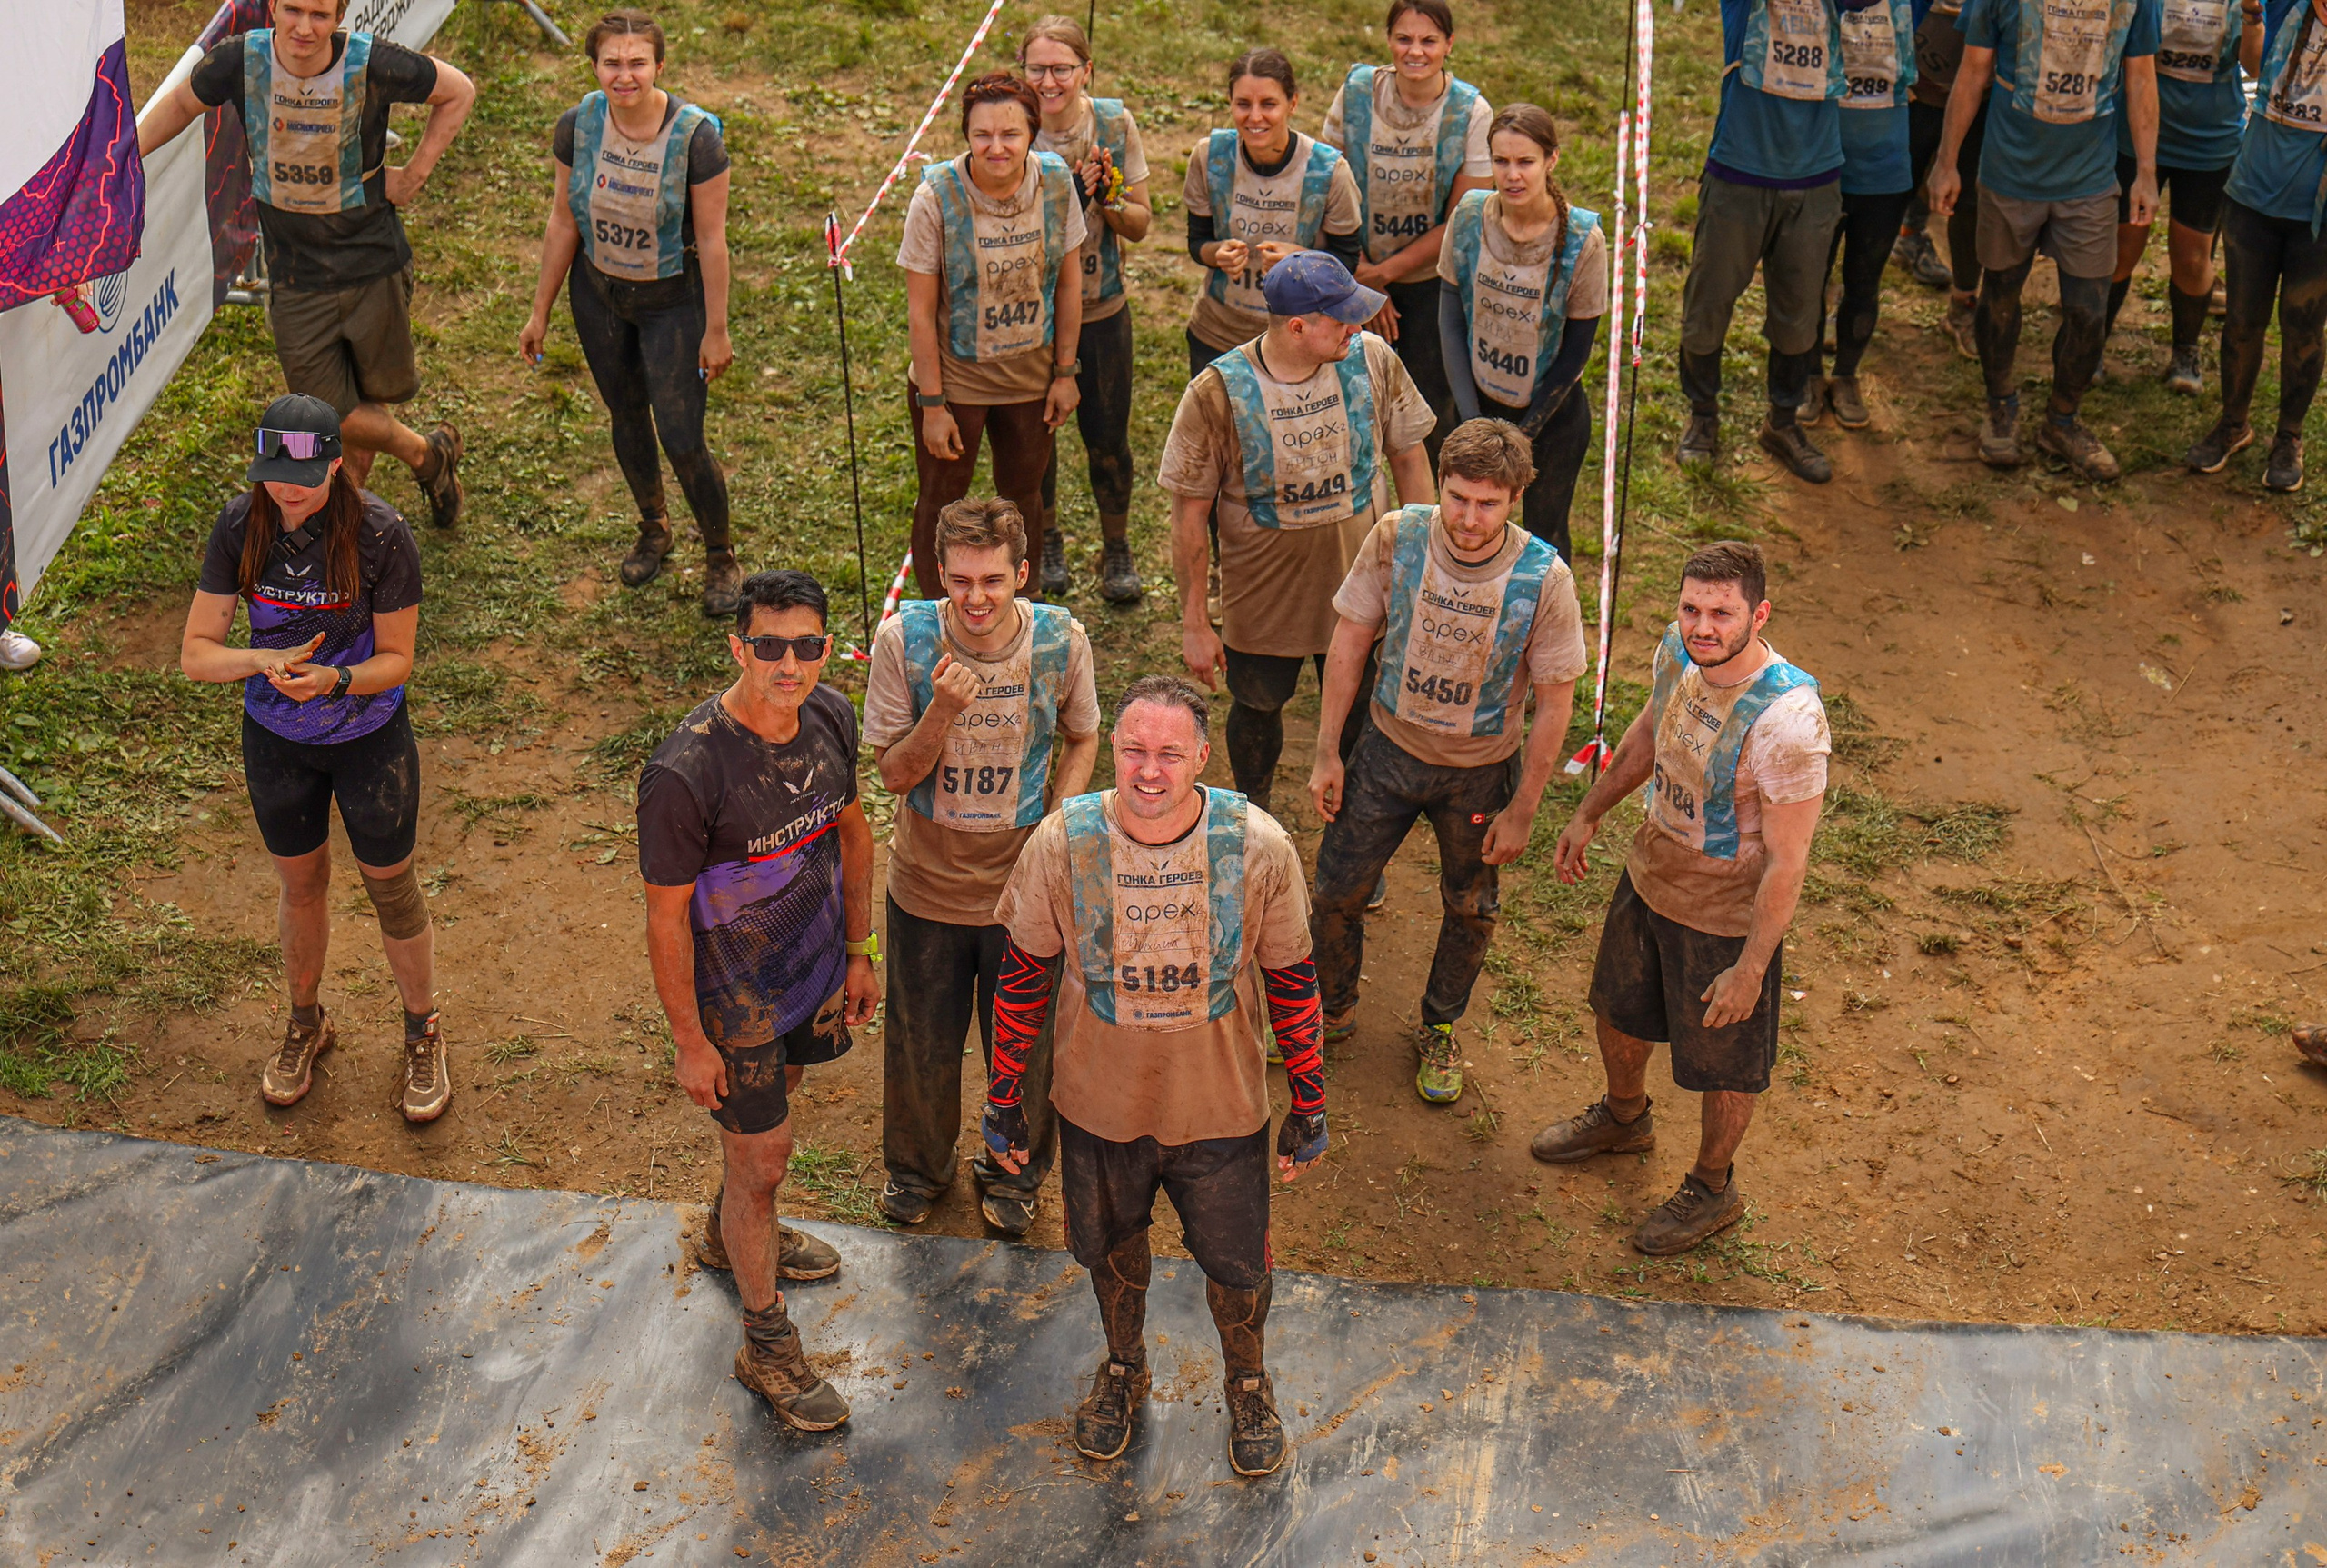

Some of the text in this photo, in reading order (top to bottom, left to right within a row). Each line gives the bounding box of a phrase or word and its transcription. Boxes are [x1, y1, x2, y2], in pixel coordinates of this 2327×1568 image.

[1773, 41, 1823, 68] 5288
[1850, 77, 1889, 95] 289
[2045, 71, 2095, 95] 5281
[275, 94, 338, 106] ГОНКА ГЕРОЕВ
[602, 150, 659, 171] ГОНКА ГЕРОЕВ
[1371, 143, 1433, 155] ГОНКА ГЕРОЕВ
[275, 162, 334, 185] 5359
[1374, 166, 1427, 184] apex
[1235, 193, 1296, 209] ГОНКА ГЕРОЕВ
[595, 219, 651, 250] 5372
[1236, 217, 1288, 236] apex
[1373, 212, 1429, 237] 5446
[978, 229, 1042, 245] ГОНКА ГЕРОЕВ
[986, 255, 1039, 276] apex
[1478, 272, 1541, 296] ГОНКА ГЕРОЕВ
[984, 300, 1041, 331] 5447
[1481, 297, 1532, 323] apex
[1477, 337, 1529, 377] 5440
[48, 266, 180, 489] ГАЗПРОМБАНК
[1271, 394, 1340, 417] ГОНКА ГЕРОЕВ
[1283, 421, 1339, 449] apex
[1283, 473, 1346, 504] 5449
[1422, 590, 1496, 615] ГОНКА ГЕРОЕВ
[1422, 619, 1484, 644] apex
[985, 684, 1024, 696] ГЕРОЕВ
[1405, 667, 1473, 706] 5450
[954, 712, 1016, 731] apex
[1693, 704, 1722, 730] ГЕРОЕВ
[943, 765, 1014, 794] 5187
[747, 792, 847, 854] ИНСТРУКТО
[1117, 870, 1203, 885] ГОНКА ГЕРОЕВ
[1126, 901, 1196, 924] apex
[1121, 961, 1201, 993] 5184
[1146, 1010, 1193, 1019] ГАЗПРОМБАНК
